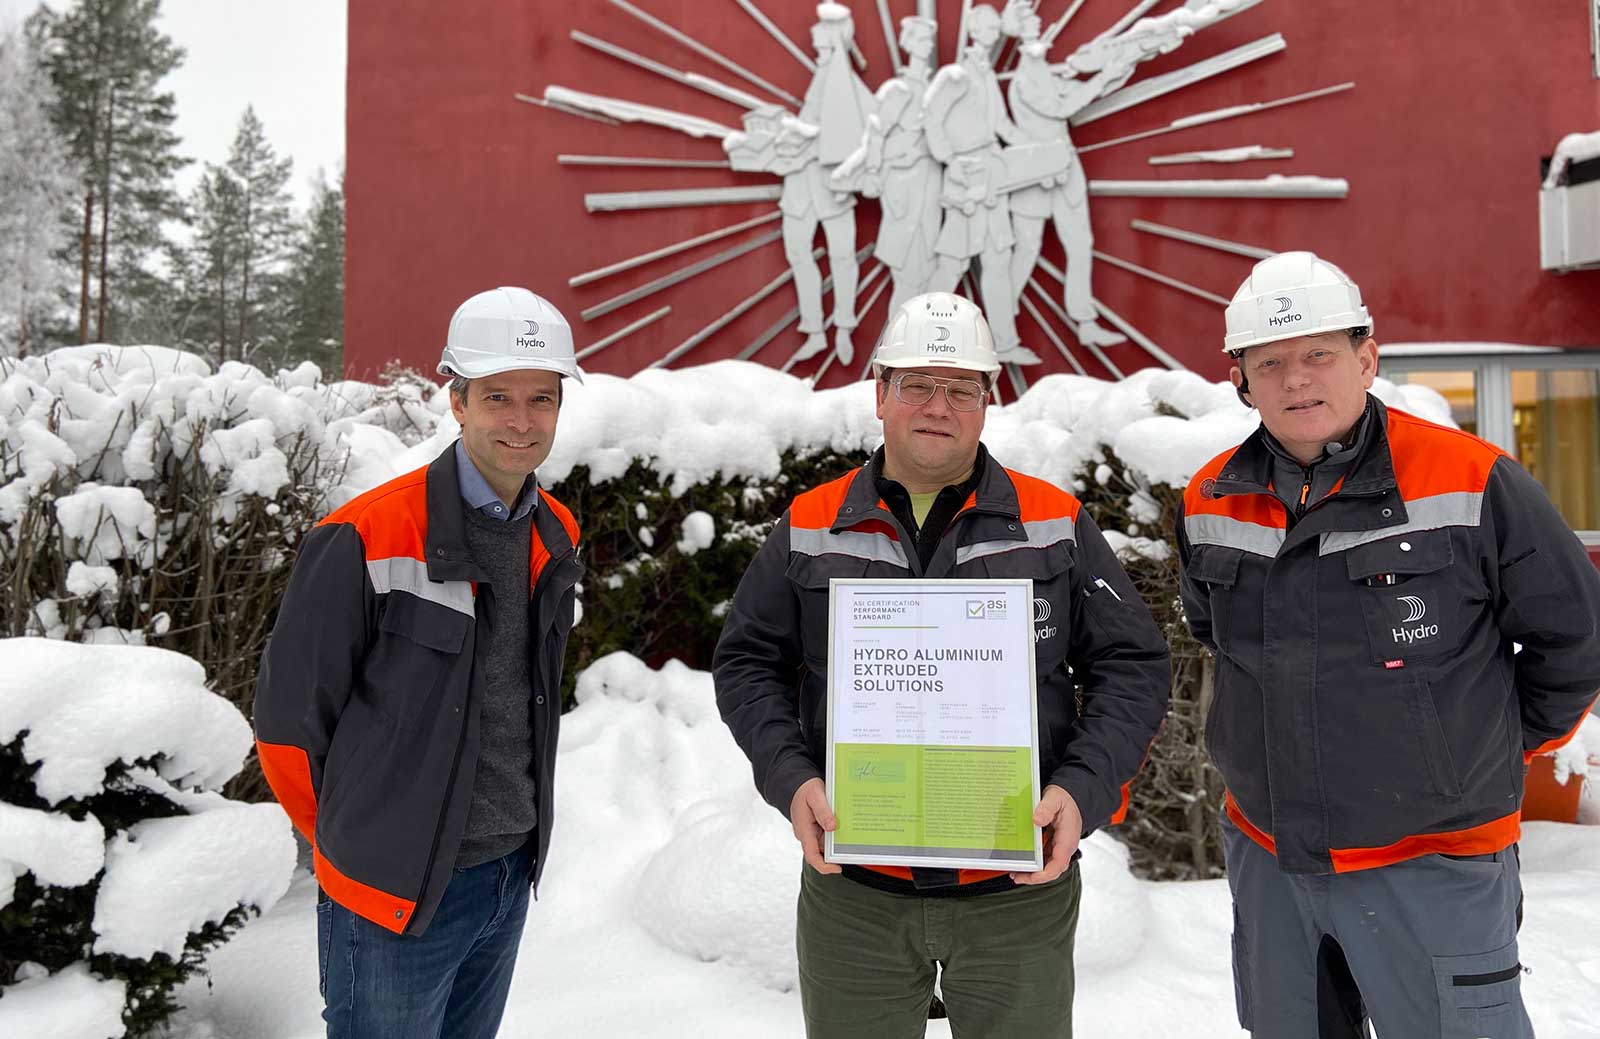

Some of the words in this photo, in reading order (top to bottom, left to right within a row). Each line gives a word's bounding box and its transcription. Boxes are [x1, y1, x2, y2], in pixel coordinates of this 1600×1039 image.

[1269, 312, 1302, 327] Hydro
[516, 337, 545, 348] Hydro
[926, 343, 956, 354] Hydro
[987, 600, 1007, 609] asi
[1034, 625, 1057, 643] ydro
[1392, 624, 1438, 644] Hydro
[853, 648, 909, 661] HYDRO
[913, 648, 1003, 662] ALUMINIUM
[853, 664, 938, 677] EXTRUDED
[853, 680, 944, 693] SOLUTIONS
